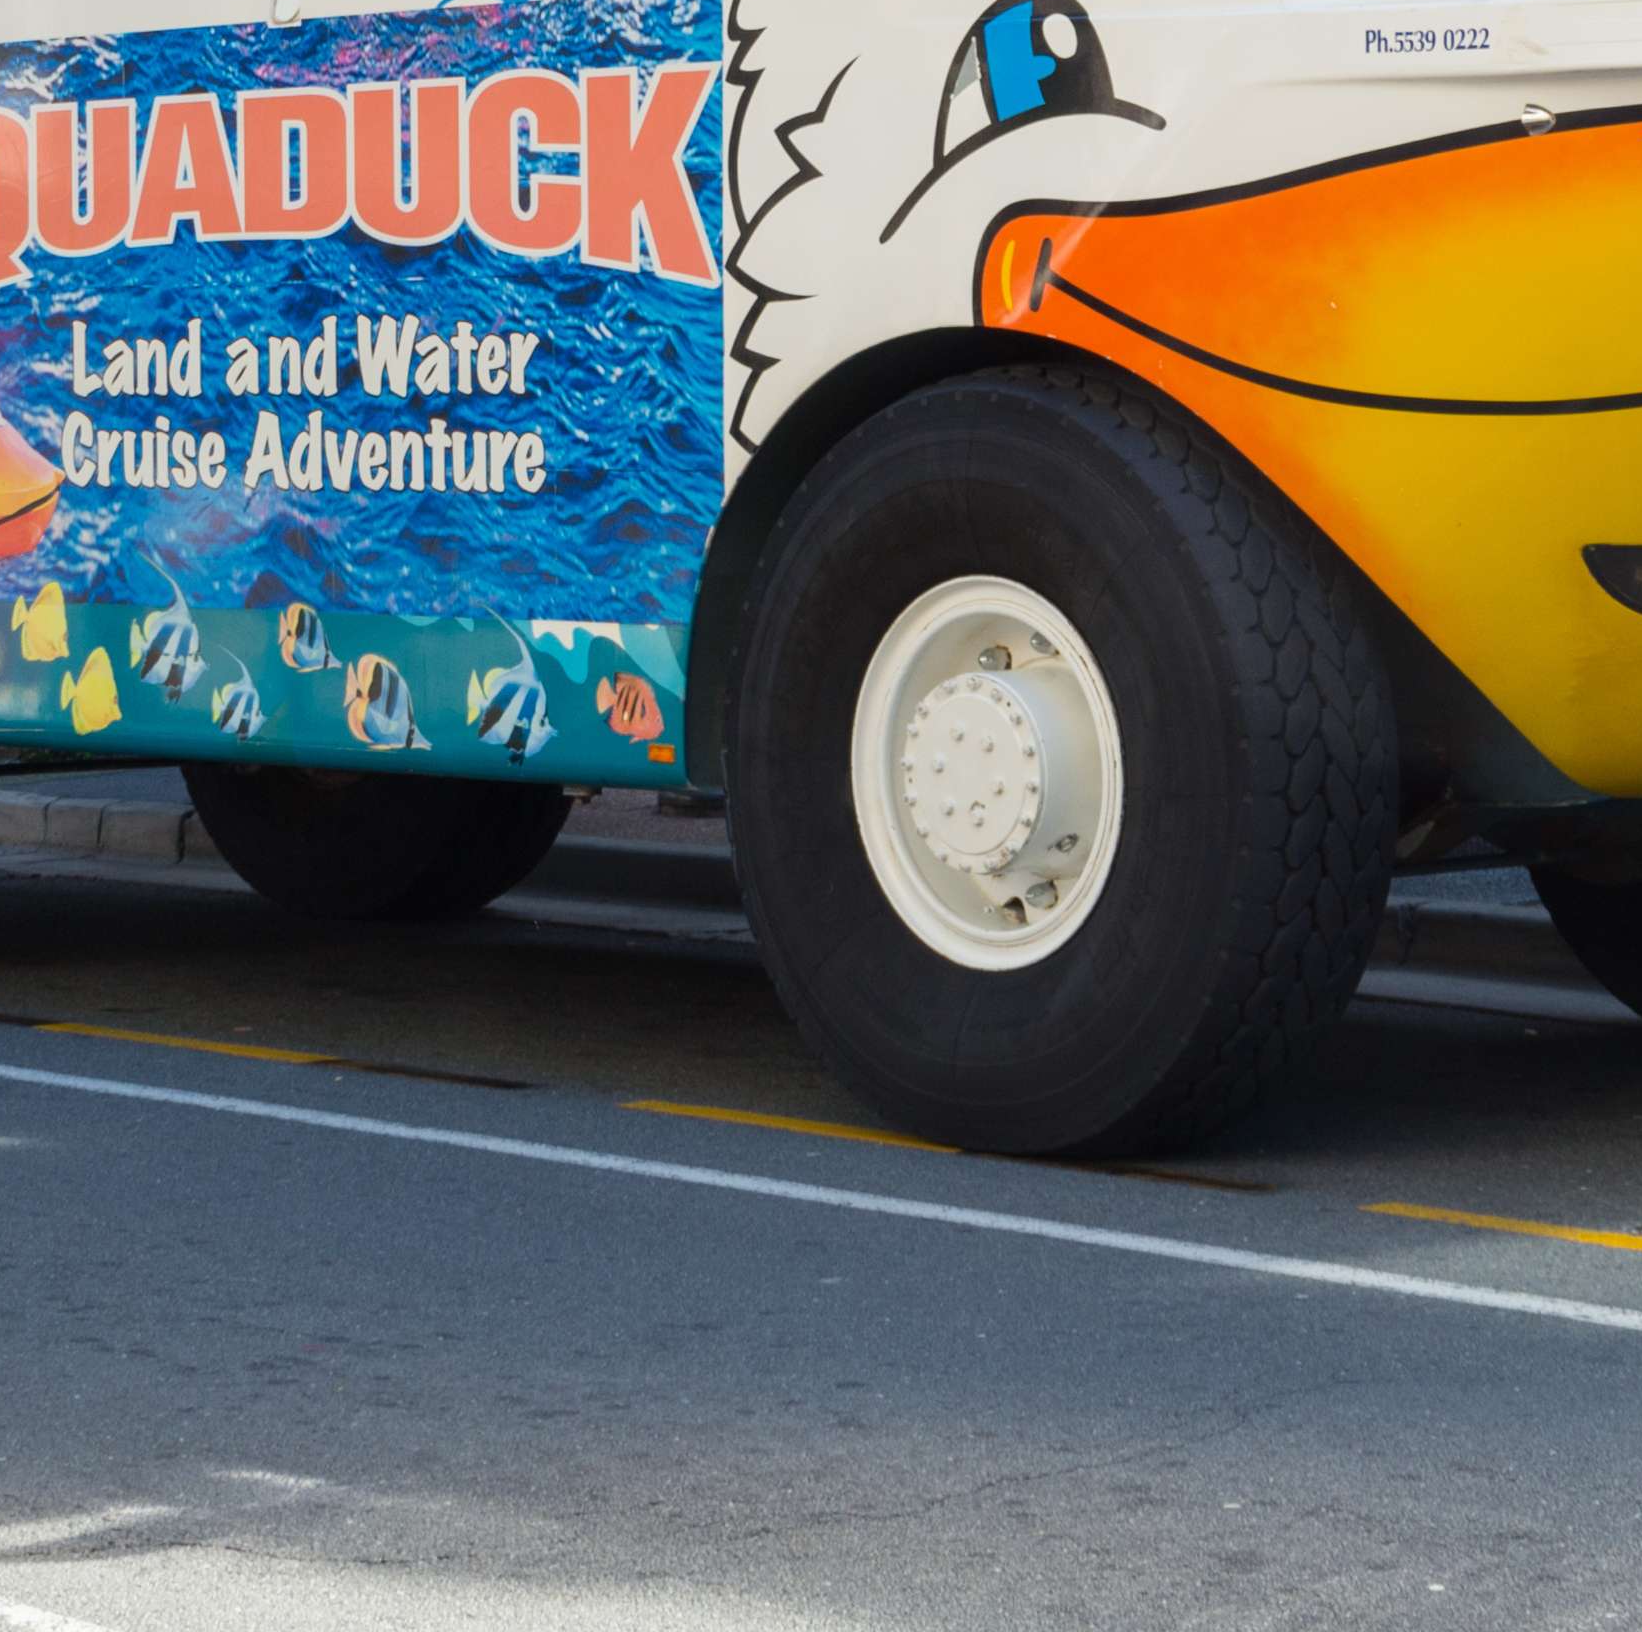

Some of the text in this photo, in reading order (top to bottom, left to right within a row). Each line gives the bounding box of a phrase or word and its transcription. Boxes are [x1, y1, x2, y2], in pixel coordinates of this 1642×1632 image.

[1365, 27, 1491, 54] Ph.5539 0222
[71, 313, 541, 399] Land and Water
[60, 409, 548, 495] Cruise Adventure
